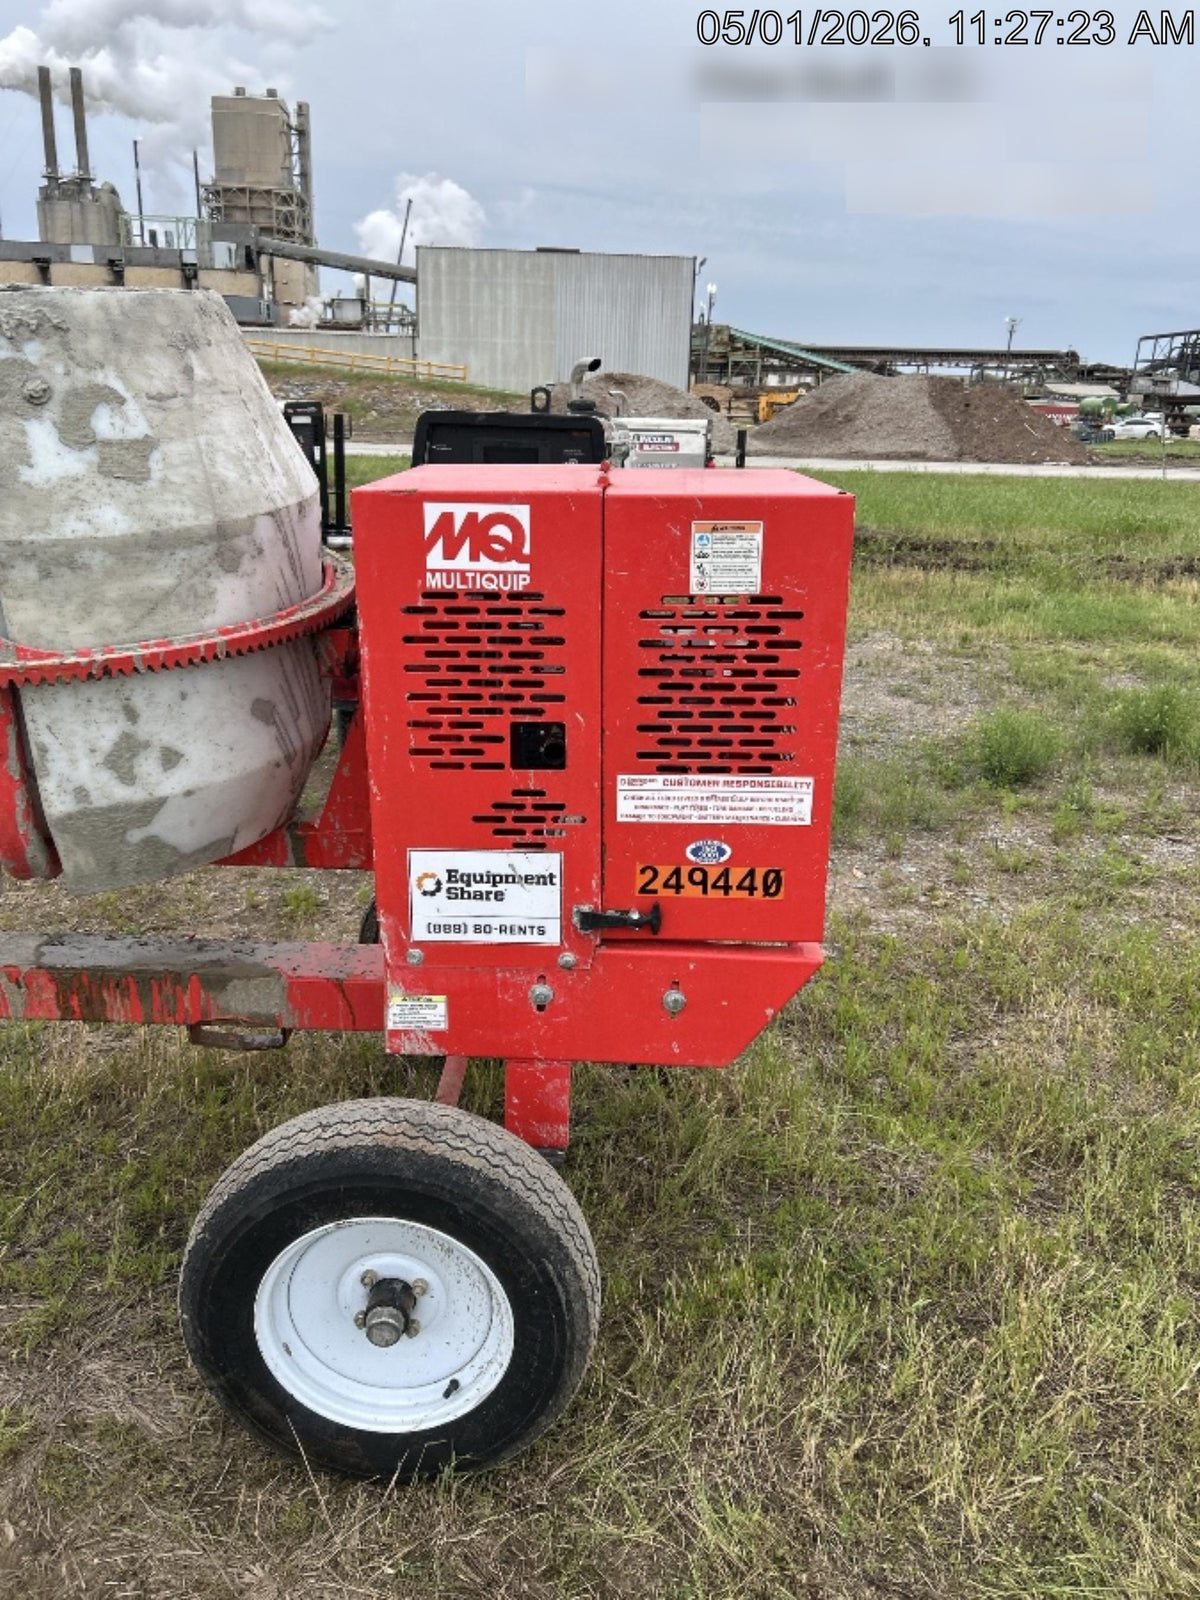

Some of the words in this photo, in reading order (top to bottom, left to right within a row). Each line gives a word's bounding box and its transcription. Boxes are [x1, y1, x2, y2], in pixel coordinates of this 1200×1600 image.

[423, 511, 530, 564] MQ
[426, 572, 530, 590] MULTIQUIP
[662, 777, 720, 788] CUSTOMER
[722, 779, 812, 790] RESPONSIBILITY
[445, 868, 557, 888] Equipment
[637, 864, 784, 898] 249440
[446, 886, 506, 902] Share
[427, 922, 469, 935] (888)
[473, 924, 547, 936] 80-RENTS
